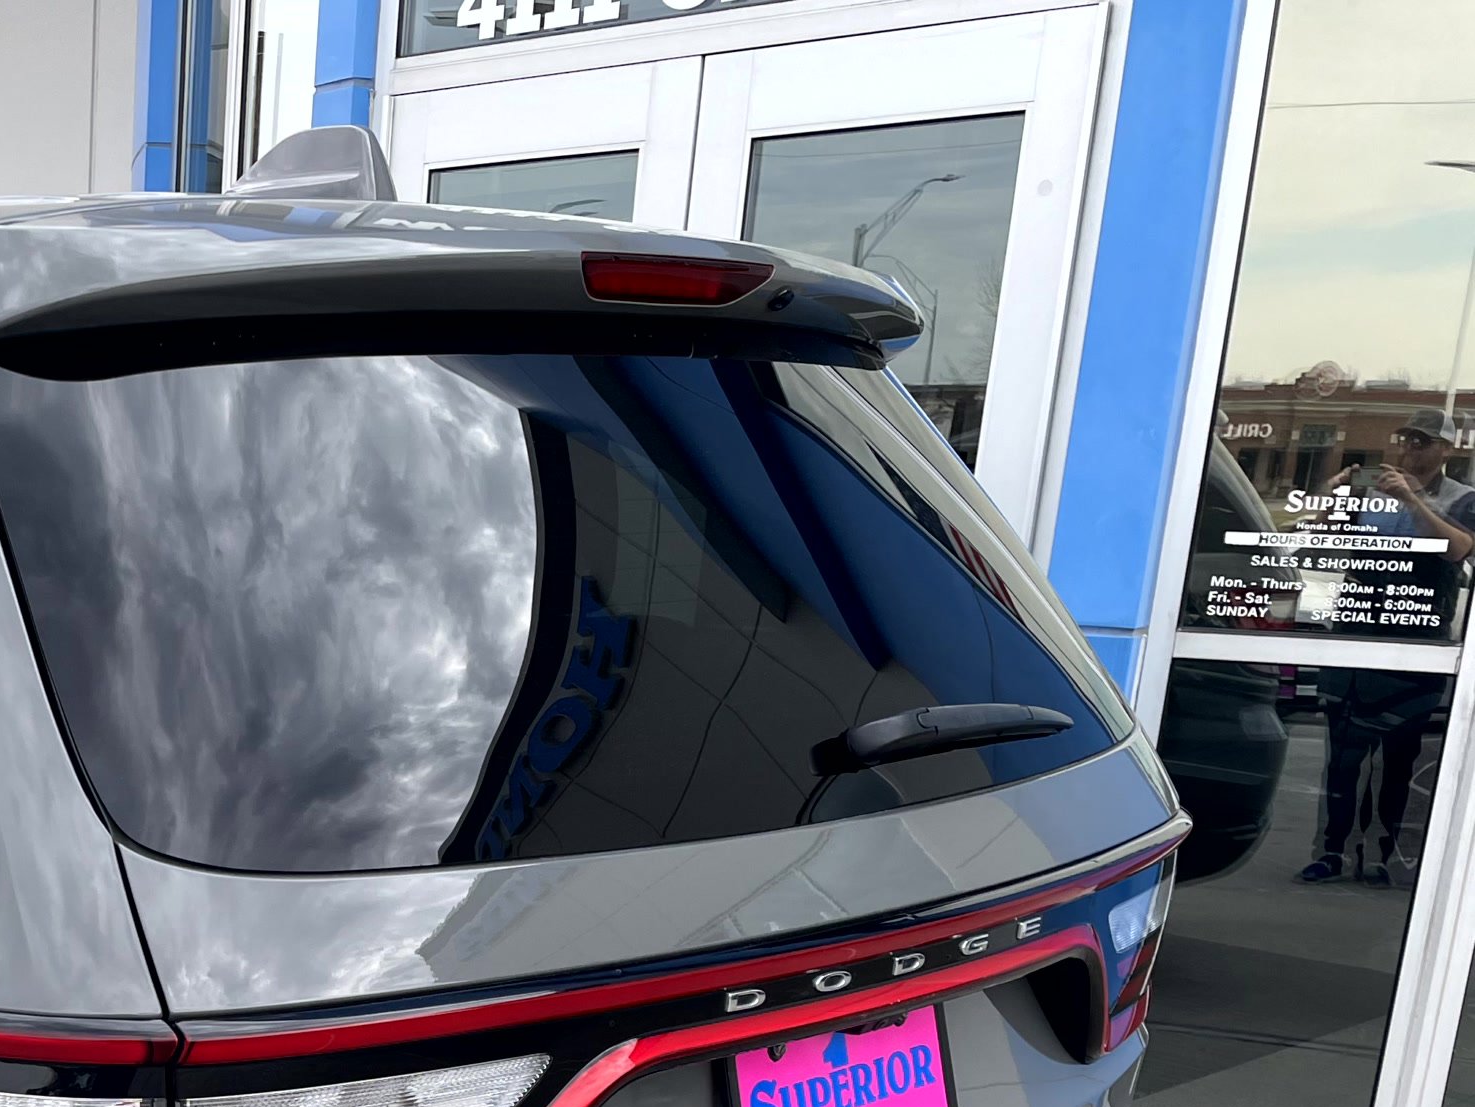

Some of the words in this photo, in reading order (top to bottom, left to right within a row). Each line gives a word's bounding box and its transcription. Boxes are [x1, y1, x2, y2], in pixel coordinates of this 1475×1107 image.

[1284, 489, 1399, 513] SUPERIOR
[1296, 522, 1328, 531] Honda
[1331, 523, 1342, 532] of
[1343, 523, 1378, 533] Omaha
[1259, 534, 1307, 546] HOURS
[1310, 536, 1329, 547] OF
[1332, 536, 1413, 549] OPERATION
[1250, 555, 1299, 568] SALES
[1302, 557, 1313, 568] &
[1317, 557, 1414, 572] SHOWROOM
[1210, 575, 1247, 588] Mon.
[1385, 584, 1435, 597] 8:00PM
[1207, 591, 1231, 603] Fri.
[1244, 591, 1273, 605] Sat.
[1206, 604, 1269, 618] SUNDAY
[1383, 599, 1432, 612] 6:00PM
[1310, 609, 1375, 624] SPECIAL
[1379, 612, 1441, 627] EVENTS
[725, 916, 1042, 1013] DODGE
